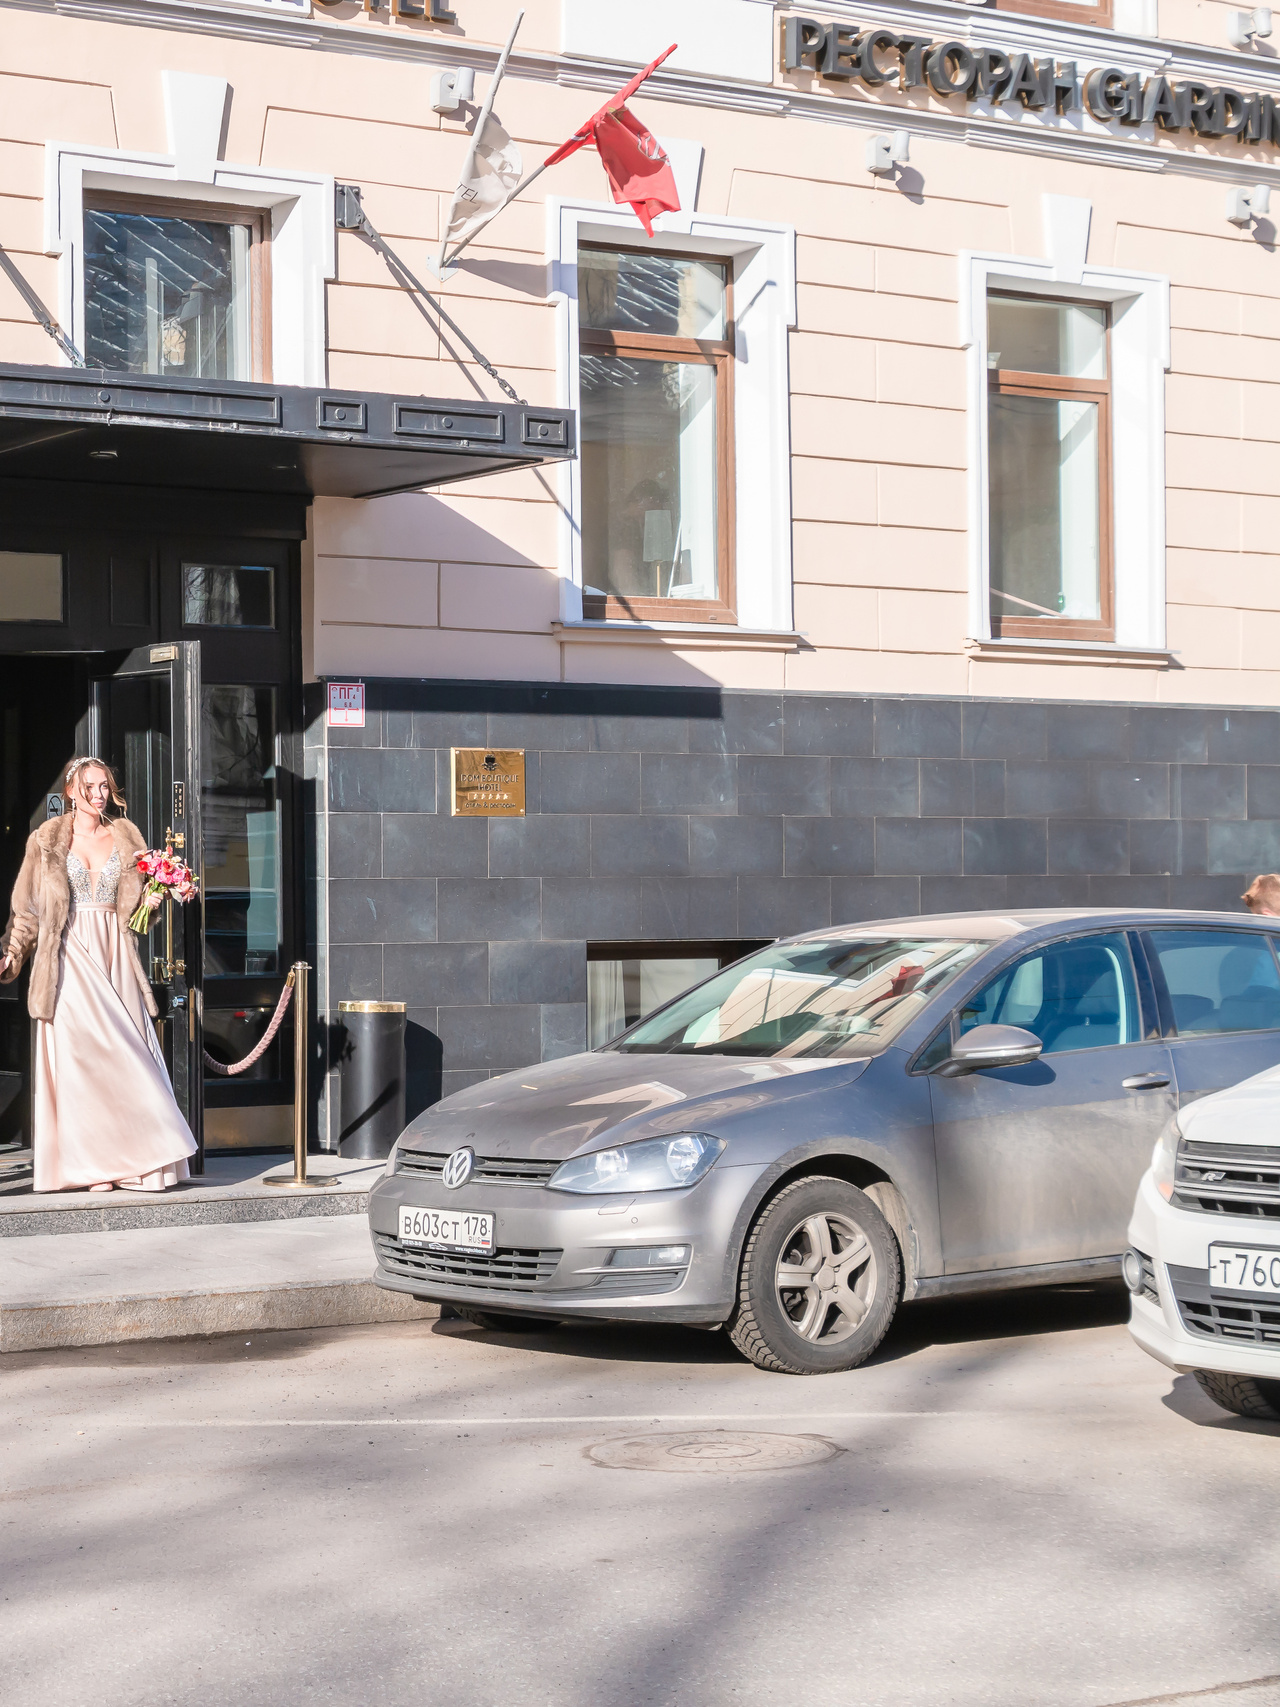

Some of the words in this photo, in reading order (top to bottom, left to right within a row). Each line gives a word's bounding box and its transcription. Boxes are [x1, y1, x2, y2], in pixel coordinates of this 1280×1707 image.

[780, 16, 1079, 113] РЕСТОРАН
[460, 774, 480, 782] DOM
[481, 774, 519, 784] BOUTIQUE
[477, 783, 502, 791] HOTEL
[468, 1236, 481, 1244] RUS
